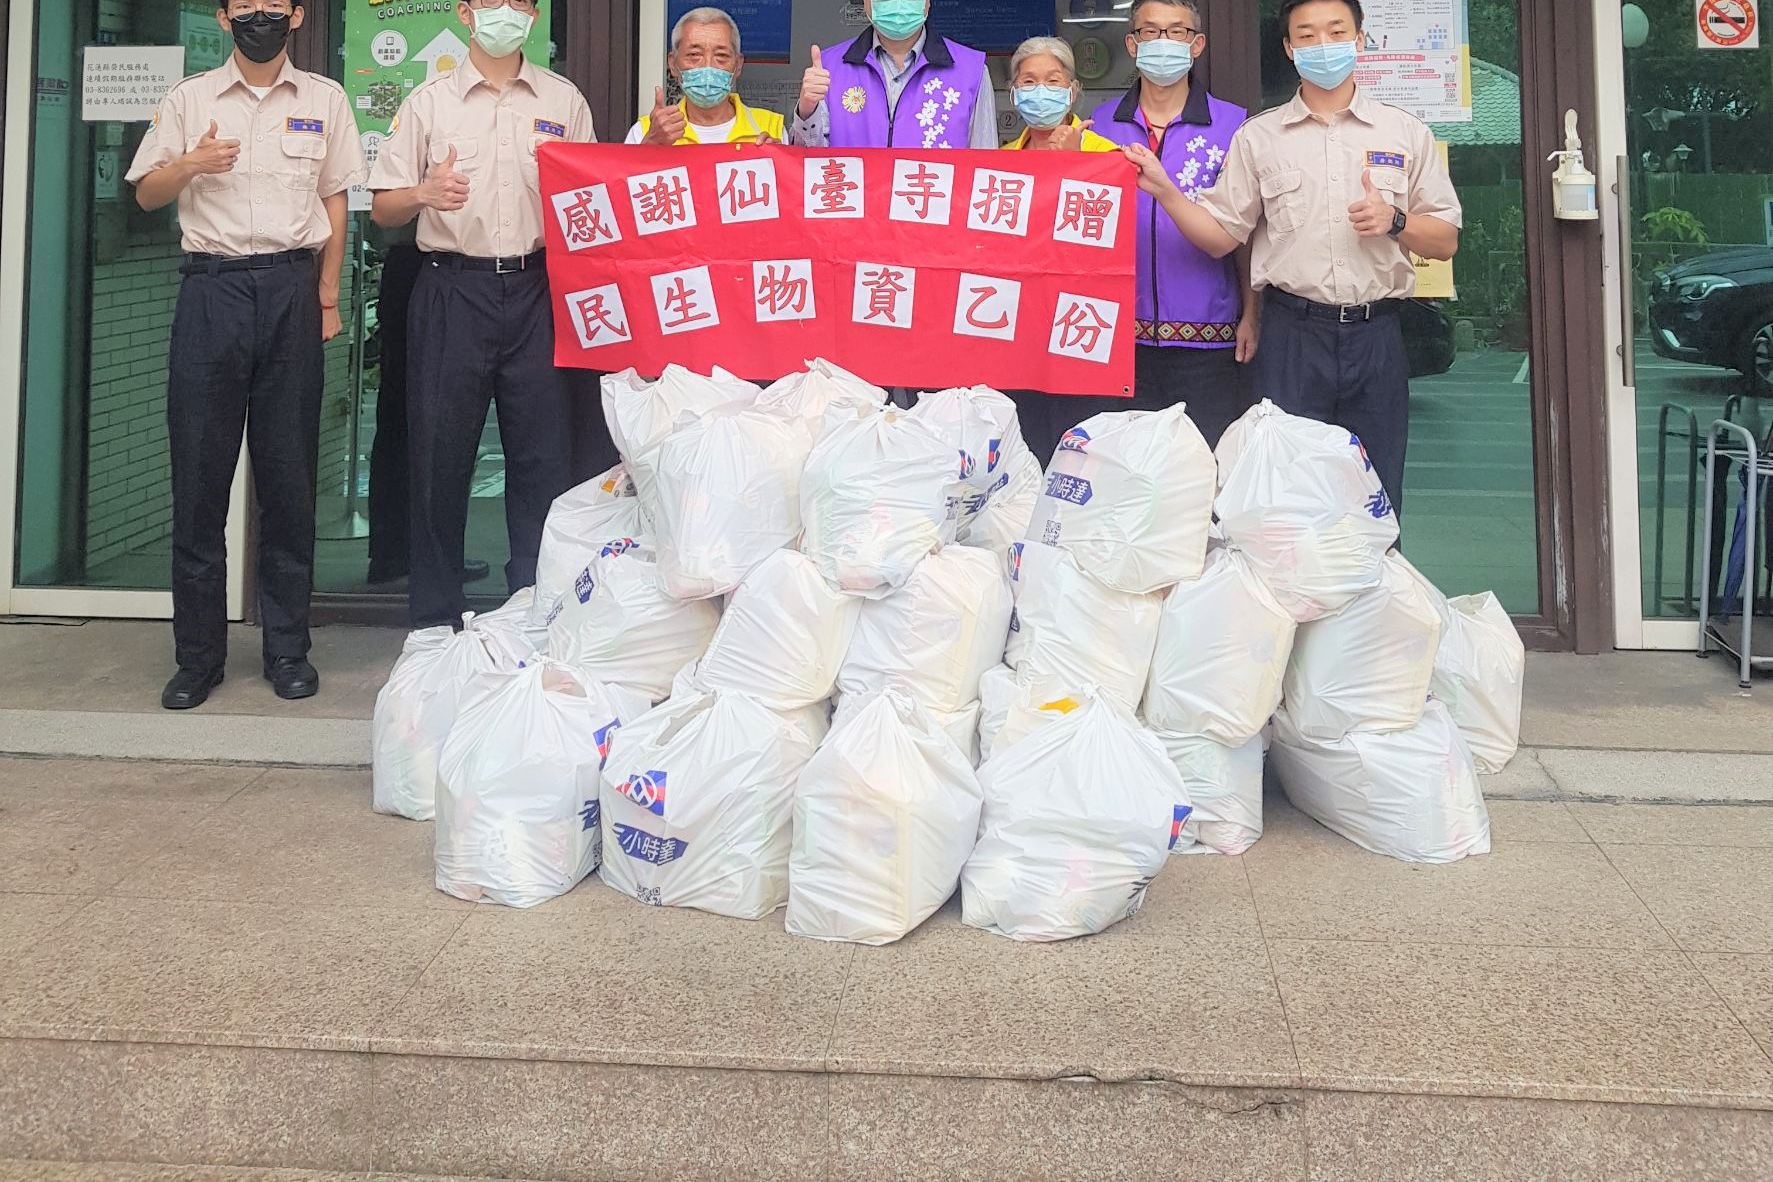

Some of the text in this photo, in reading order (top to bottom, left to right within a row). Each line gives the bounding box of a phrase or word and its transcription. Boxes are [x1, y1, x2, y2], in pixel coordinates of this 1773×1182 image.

[377, 1, 452, 19] COACHING
[140, 85, 172, 93] 03-8357
[564, 158, 1114, 244] 感謝仙臺寺捐贈
[577, 264, 1112, 353] 民生物資乙份
